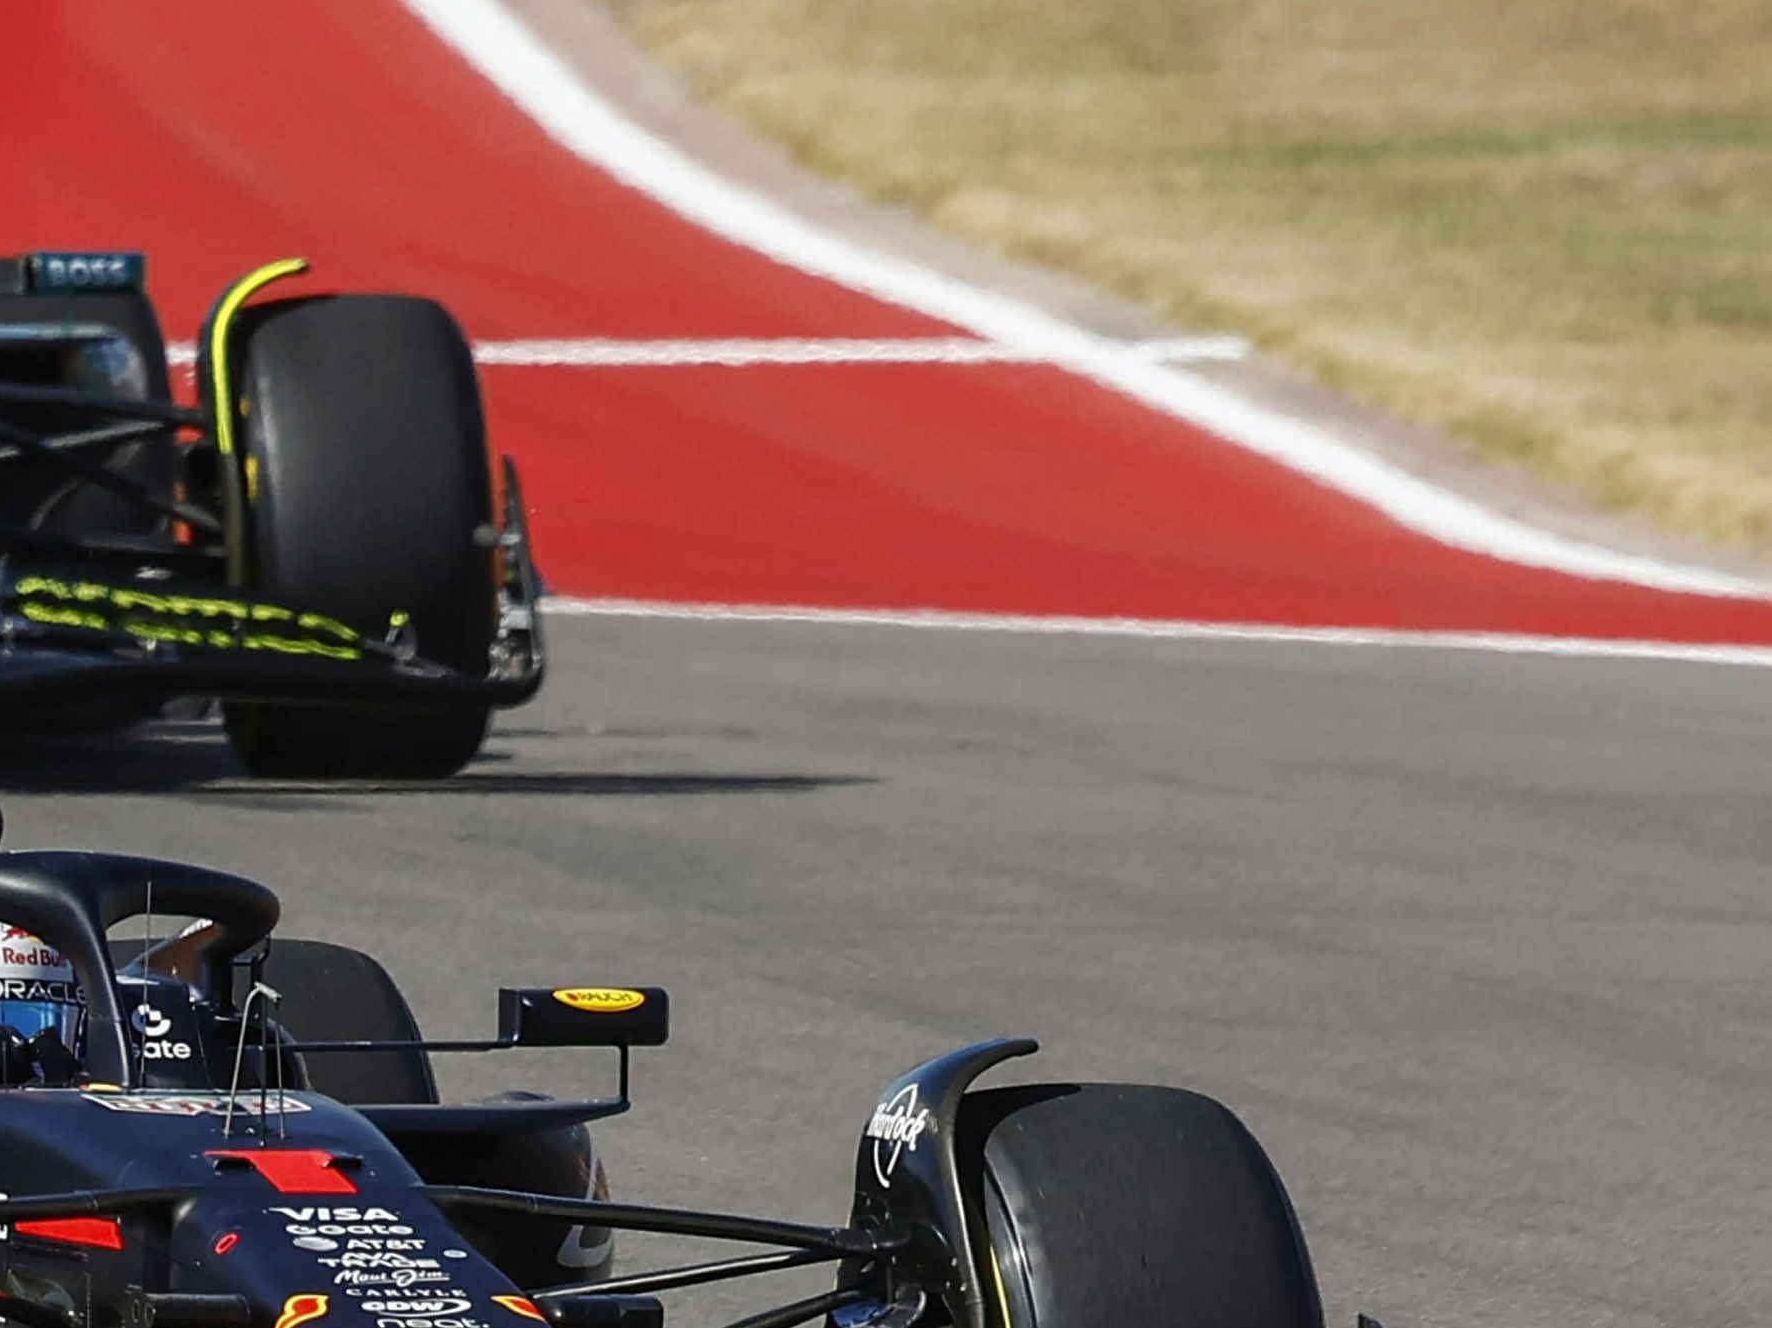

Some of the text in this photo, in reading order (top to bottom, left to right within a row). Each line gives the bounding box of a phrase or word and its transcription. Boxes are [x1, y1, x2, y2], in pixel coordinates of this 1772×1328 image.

[1, 946, 38, 966] Red
[268, 1207, 399, 1221] VISA
[346, 1239, 426, 1251] AT&T
[317, 1258, 441, 1268] TRADE
[334, 1270, 387, 1284] Maui
[345, 1288, 467, 1297] CARLYLE
